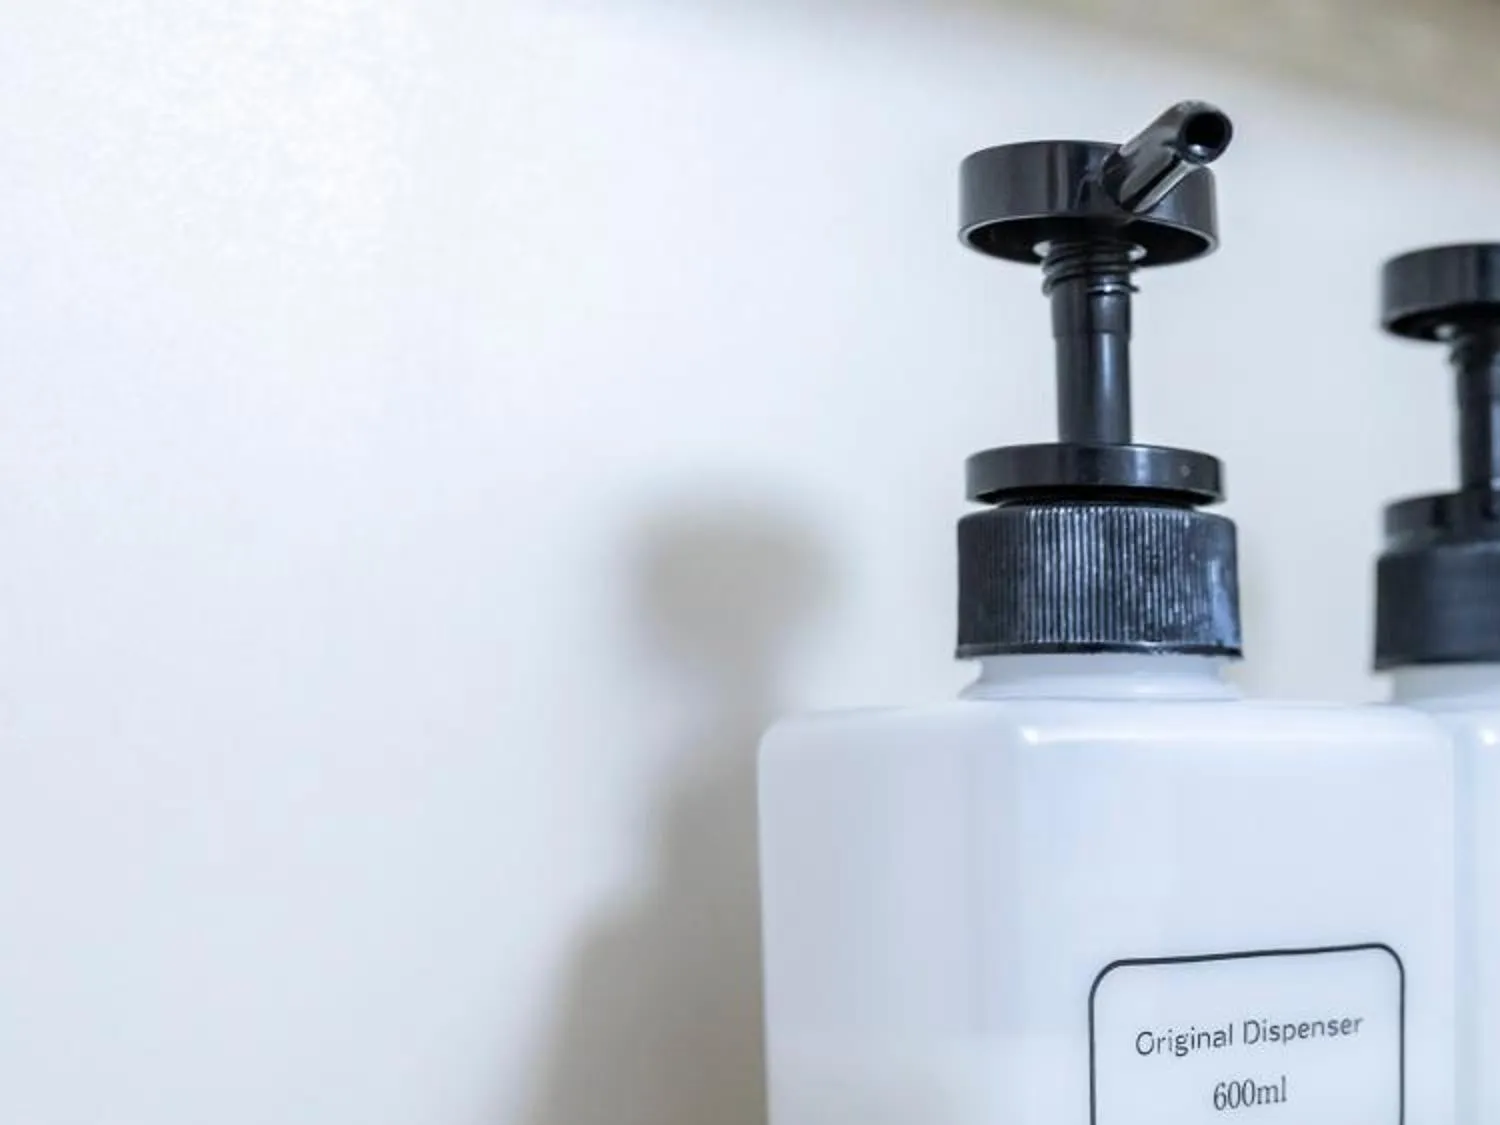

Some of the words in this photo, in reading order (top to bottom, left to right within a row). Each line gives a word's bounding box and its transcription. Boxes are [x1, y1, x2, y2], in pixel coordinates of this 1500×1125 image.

[1135, 1023, 1233, 1057] Original
[1242, 1017, 1363, 1045] Dispenser
[1213, 1075, 1287, 1111] 600ml
